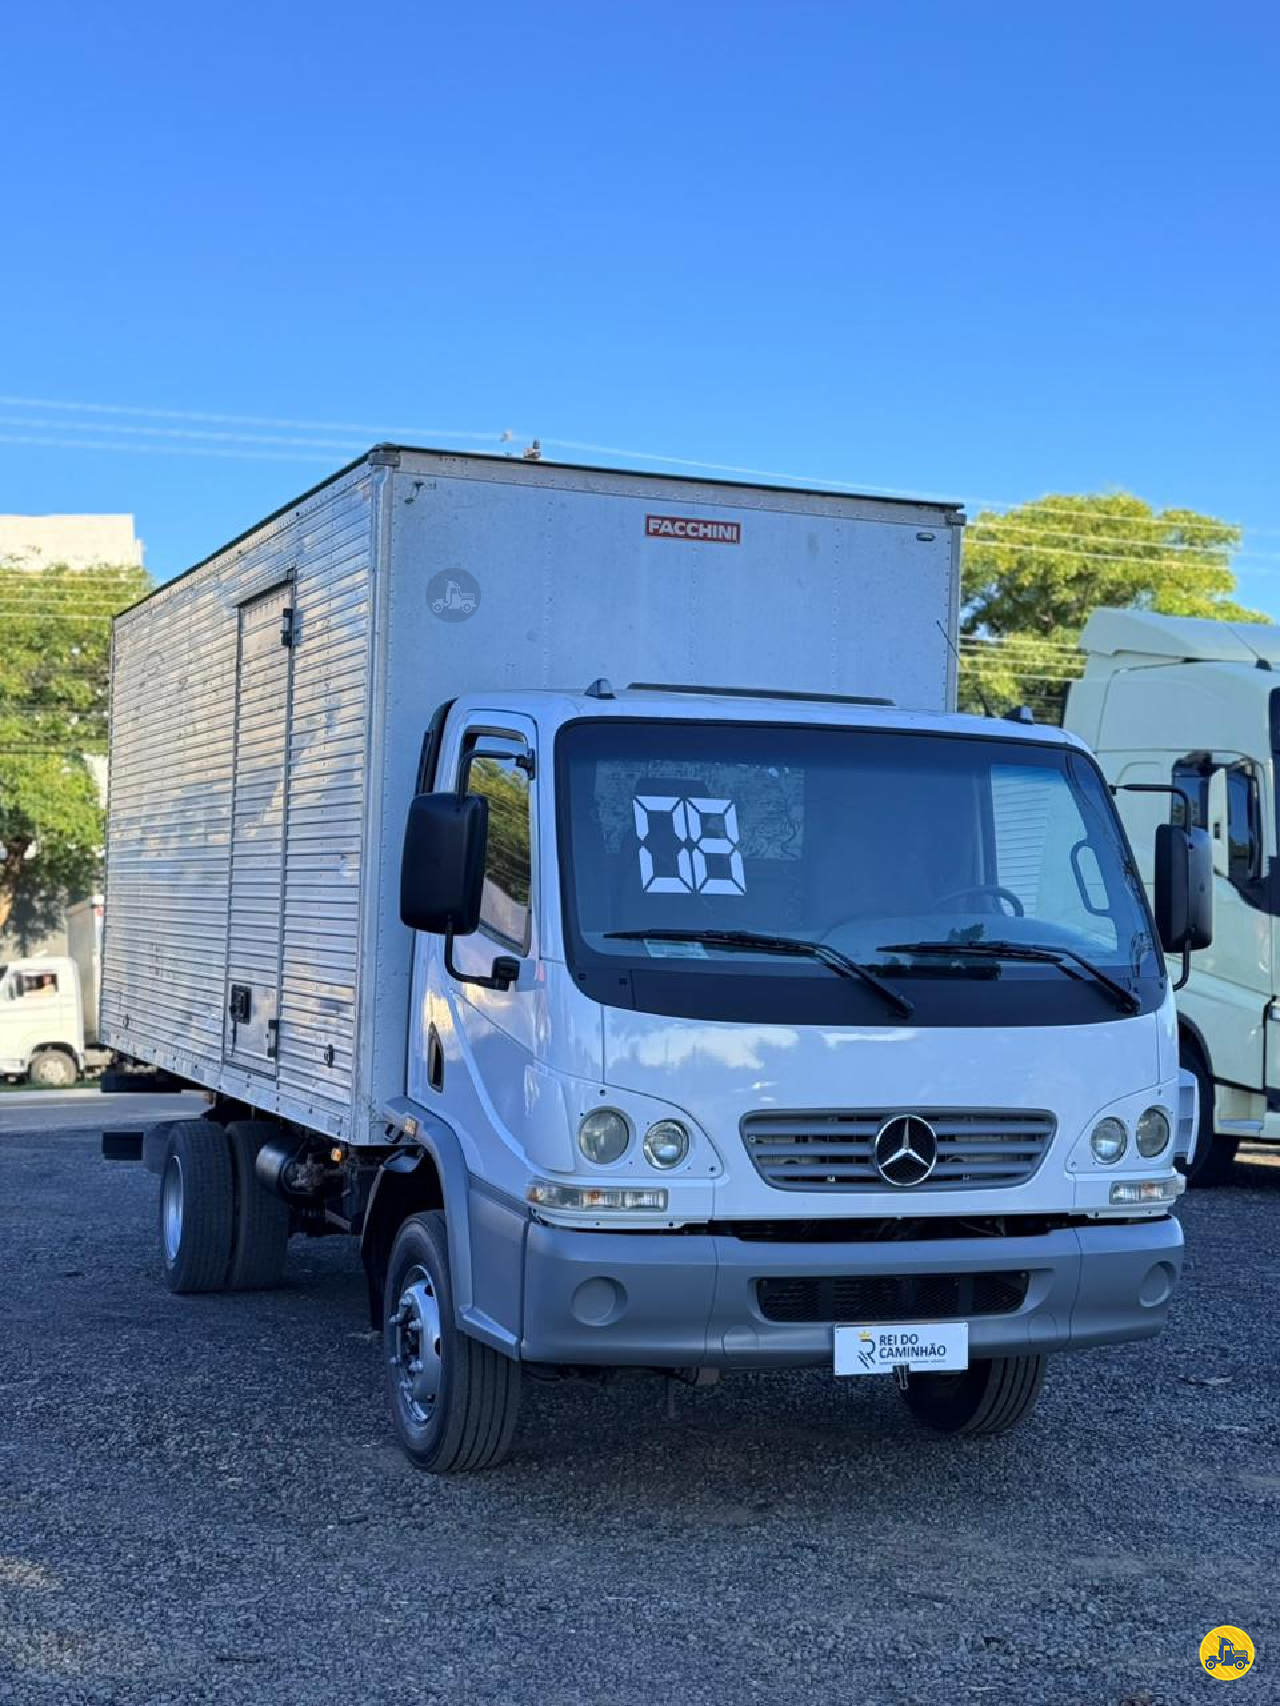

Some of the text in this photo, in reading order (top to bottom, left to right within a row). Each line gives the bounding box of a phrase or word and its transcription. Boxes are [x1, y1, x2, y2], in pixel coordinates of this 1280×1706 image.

[648, 519, 738, 541] FACCHINI
[632, 795, 747, 897] 08
[879, 1333, 918, 1346] REI DO
[879, 1342, 946, 1359] CAMINHÃO
